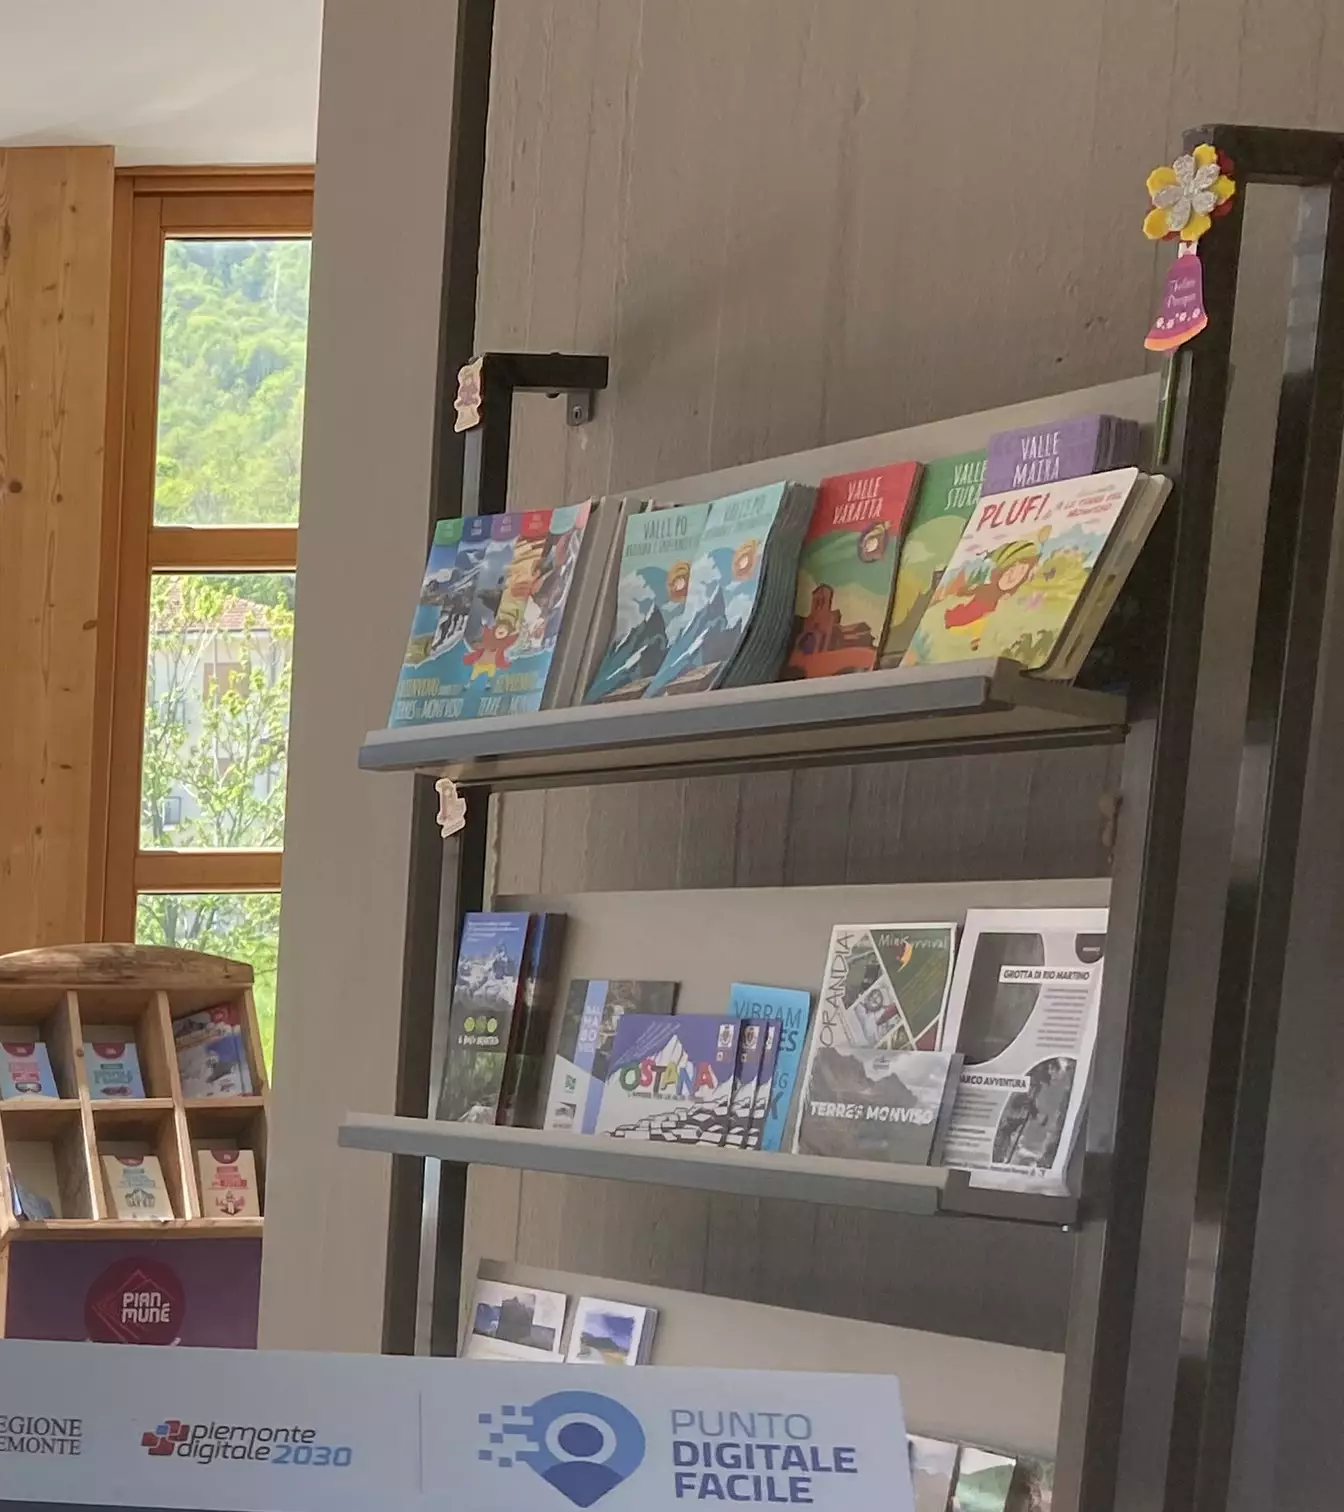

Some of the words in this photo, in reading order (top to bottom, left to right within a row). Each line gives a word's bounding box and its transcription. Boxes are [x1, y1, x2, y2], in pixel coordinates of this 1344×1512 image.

[1021, 431, 1060, 460] VALLE
[1014, 457, 1060, 487] MAIRA
[846, 476, 881, 501] VALLE
[832, 499, 883, 525] VARAITA
[977, 493, 1050, 531] PLUF!
[1004, 970, 1033, 978] GROTTA
[1056, 971, 1090, 980] MARTINO
[619, 1056, 718, 1097] OSTANA
[984, 1077, 1026, 1088] AVVENTURA
[866, 1106, 934, 1125] MONVISO
[123, 1292, 161, 1308] PIAN
[121, 1303, 170, 1324] MUNÉ
[187, 1421, 316, 1444] piemonte
[670, 1408, 812, 1440] PUNTO
[177, 1440, 269, 1464] digitale
[272, 1444, 352, 1467] 2030
[672, 1441, 858, 1474] DIGITALE
[674, 1472, 813, 1503] FACILE
